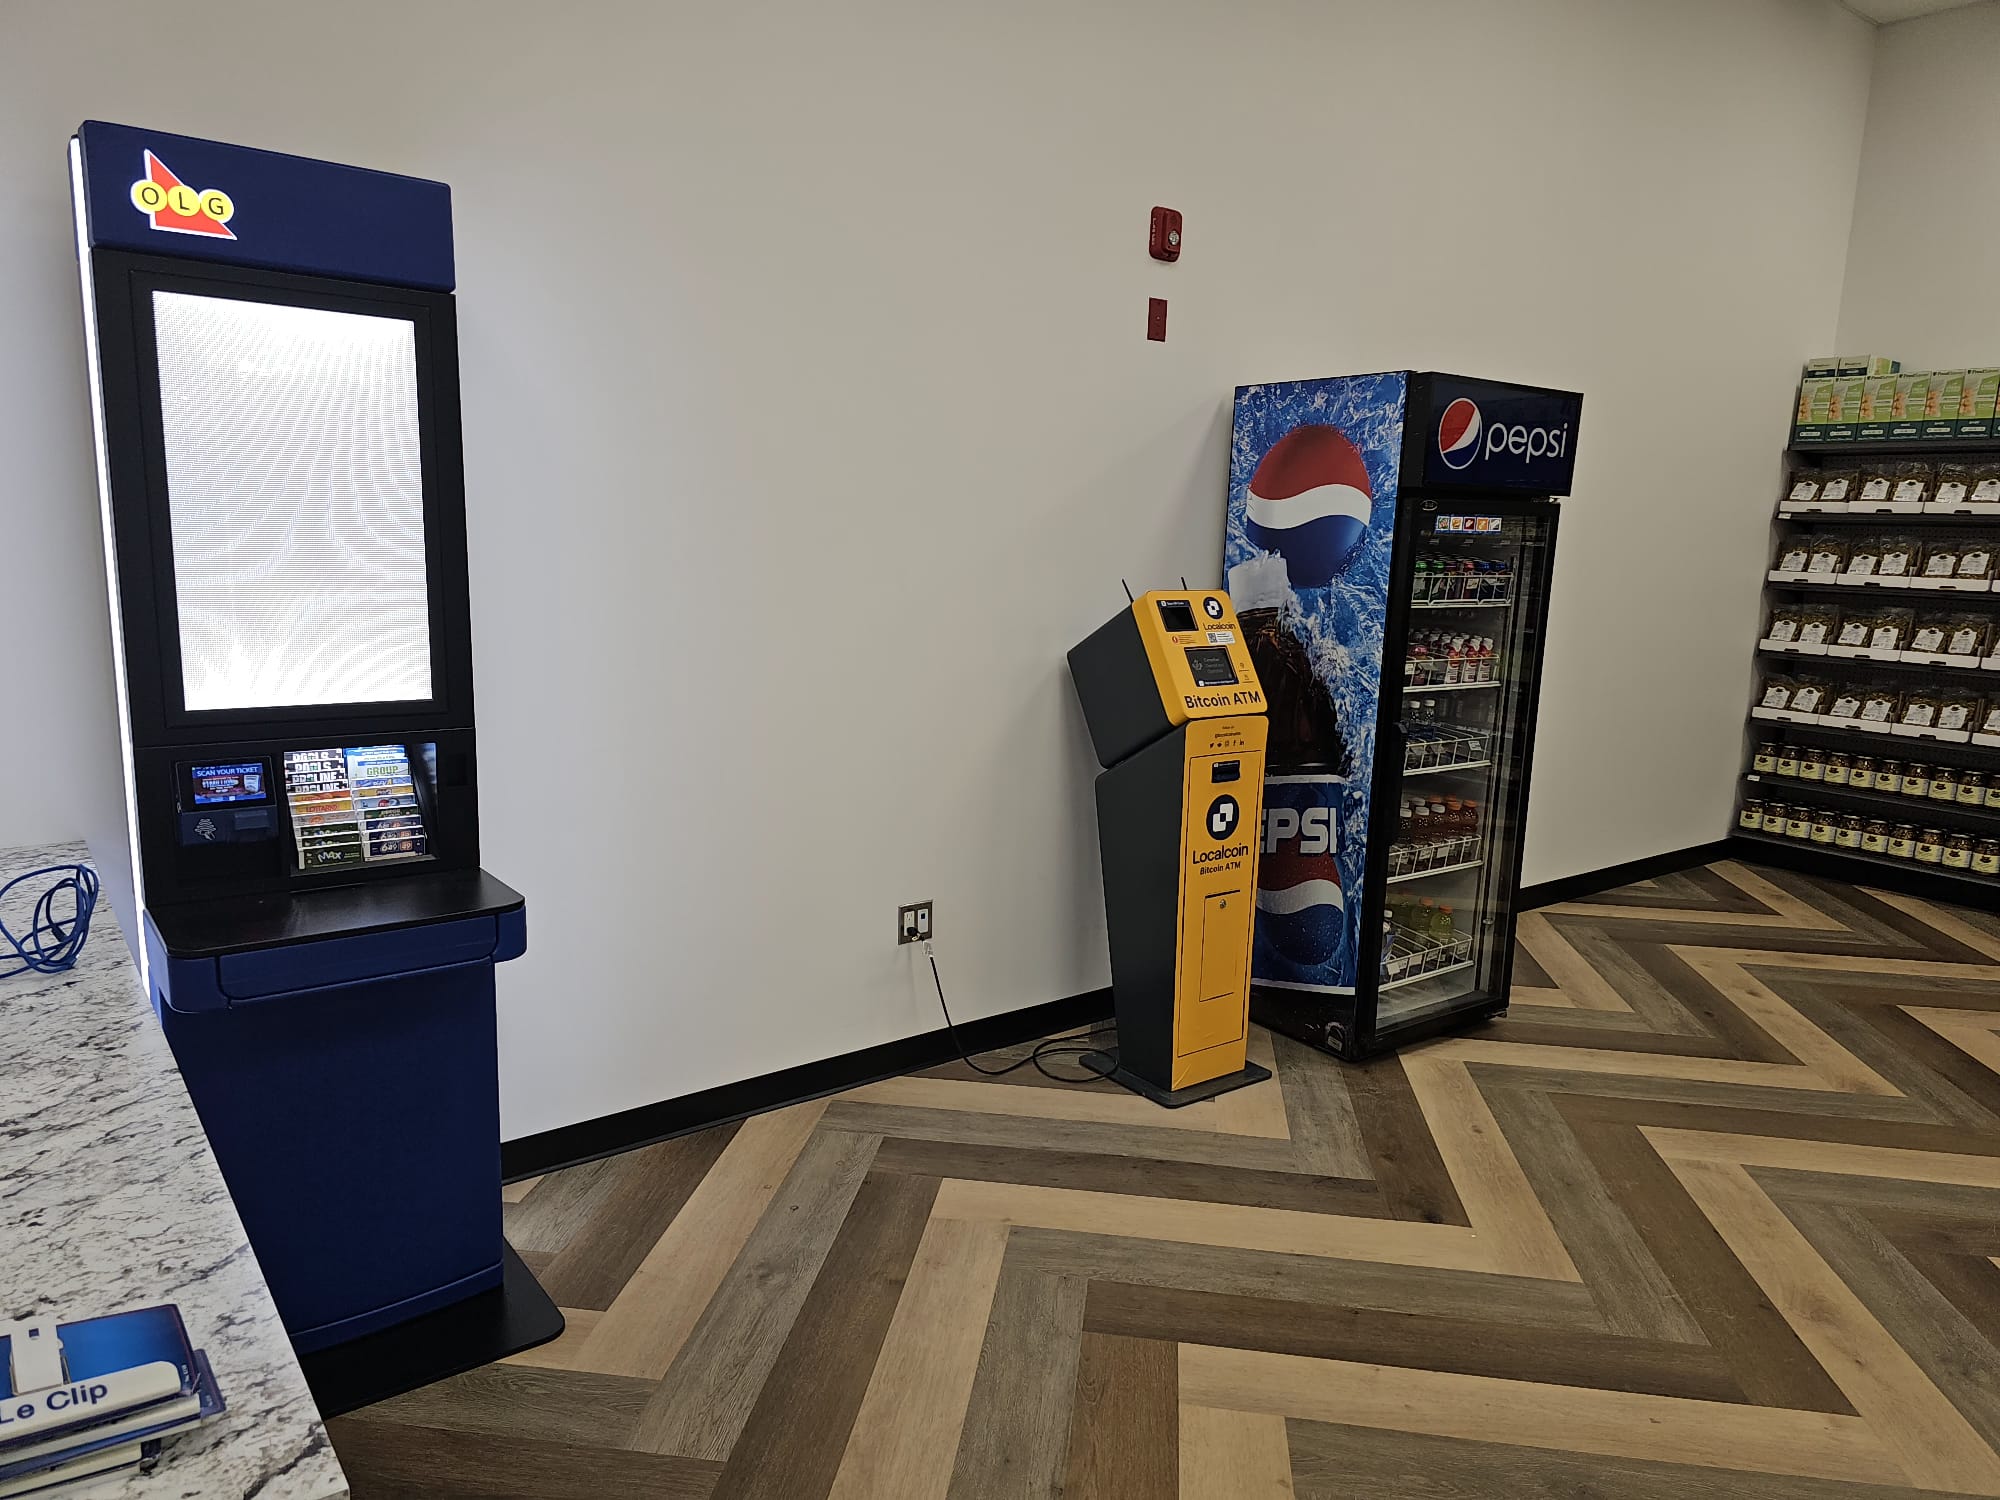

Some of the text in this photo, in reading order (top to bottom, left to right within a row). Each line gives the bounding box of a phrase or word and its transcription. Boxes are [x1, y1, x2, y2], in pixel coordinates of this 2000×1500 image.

[140, 185, 226, 217] OLG
[1485, 422, 1568, 463] pepsi
[1184, 690, 1262, 709] Bitcoin ATM
[236, 766, 259, 774] TICKET
[367, 766, 399, 776] GROUP
[1261, 807, 1337, 853] PSI
[1192, 843, 1249, 864] Localcoin
[1200, 861, 1241, 875] Bitcoin ATM
[0, 1383, 108, 1424] Le Clip
